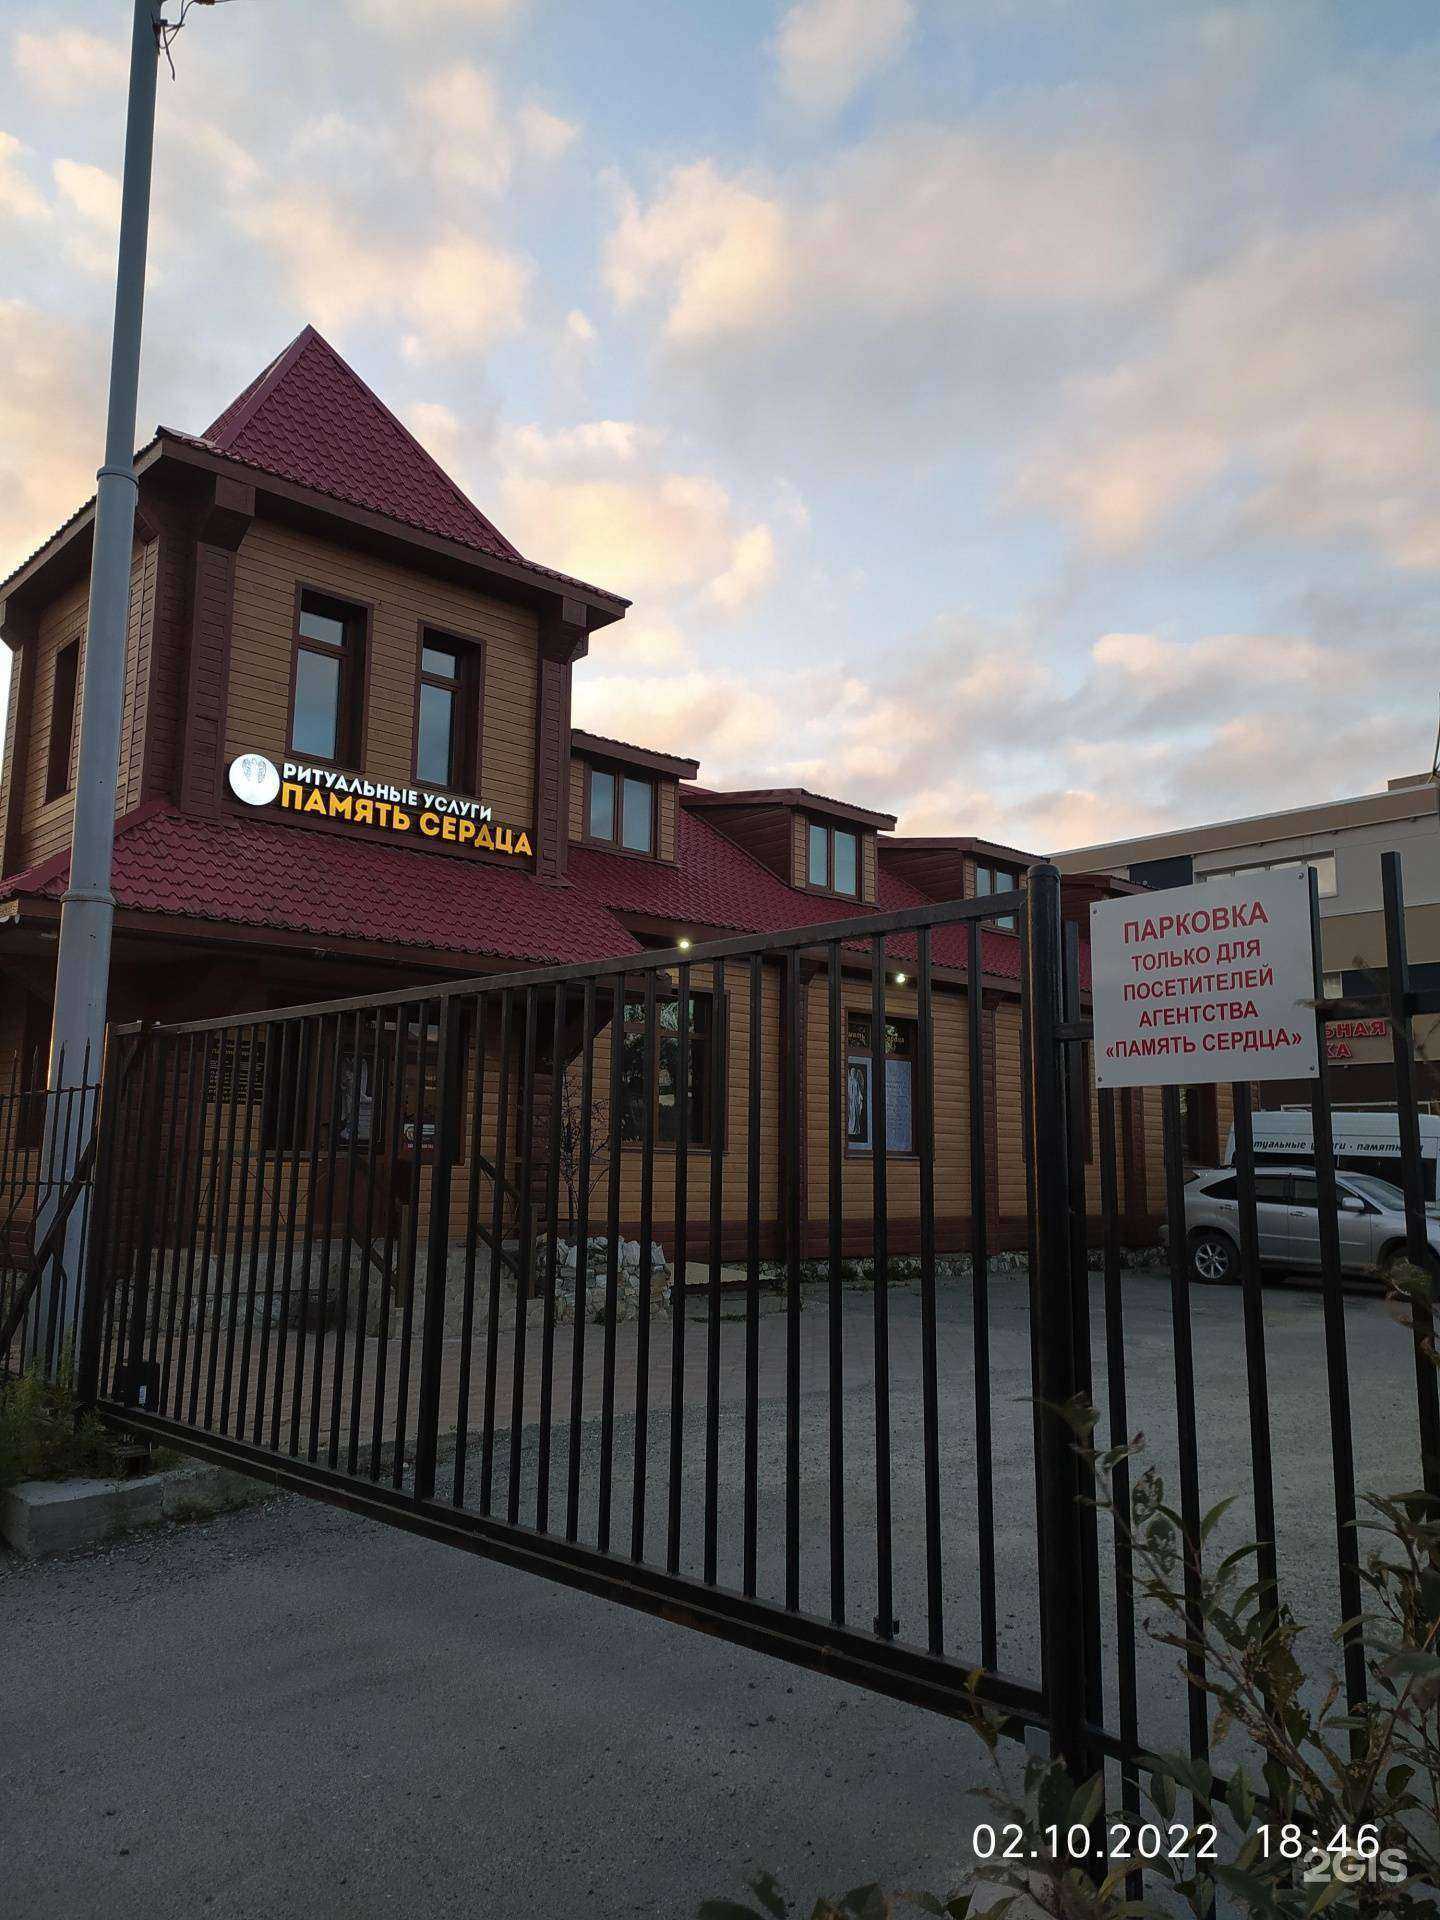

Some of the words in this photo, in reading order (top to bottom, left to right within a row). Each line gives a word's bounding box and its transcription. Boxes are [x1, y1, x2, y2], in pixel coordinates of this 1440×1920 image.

[283, 762, 418, 807] РИТУАЛЬНЫЕ
[422, 792, 493, 823] УСЛУГИ
[281, 781, 411, 832] ПАМЯТЬ
[419, 812, 534, 857] СЕРДЦА
[1123, 901, 1270, 944] ПАРКОВКА
[1131, 946, 1211, 972] ТОЛЬКО
[1216, 939, 1262, 964] ДЛЯ
[1123, 963, 1274, 1001] ПОСЕТИТЕЛЕЙ
[1138, 1000, 1259, 1027] АГЕНТСТВА
[1105, 1035, 1197, 1058] «ПАМЯТЬ
[1202, 1028, 1302, 1053] СЕРДЦА»
